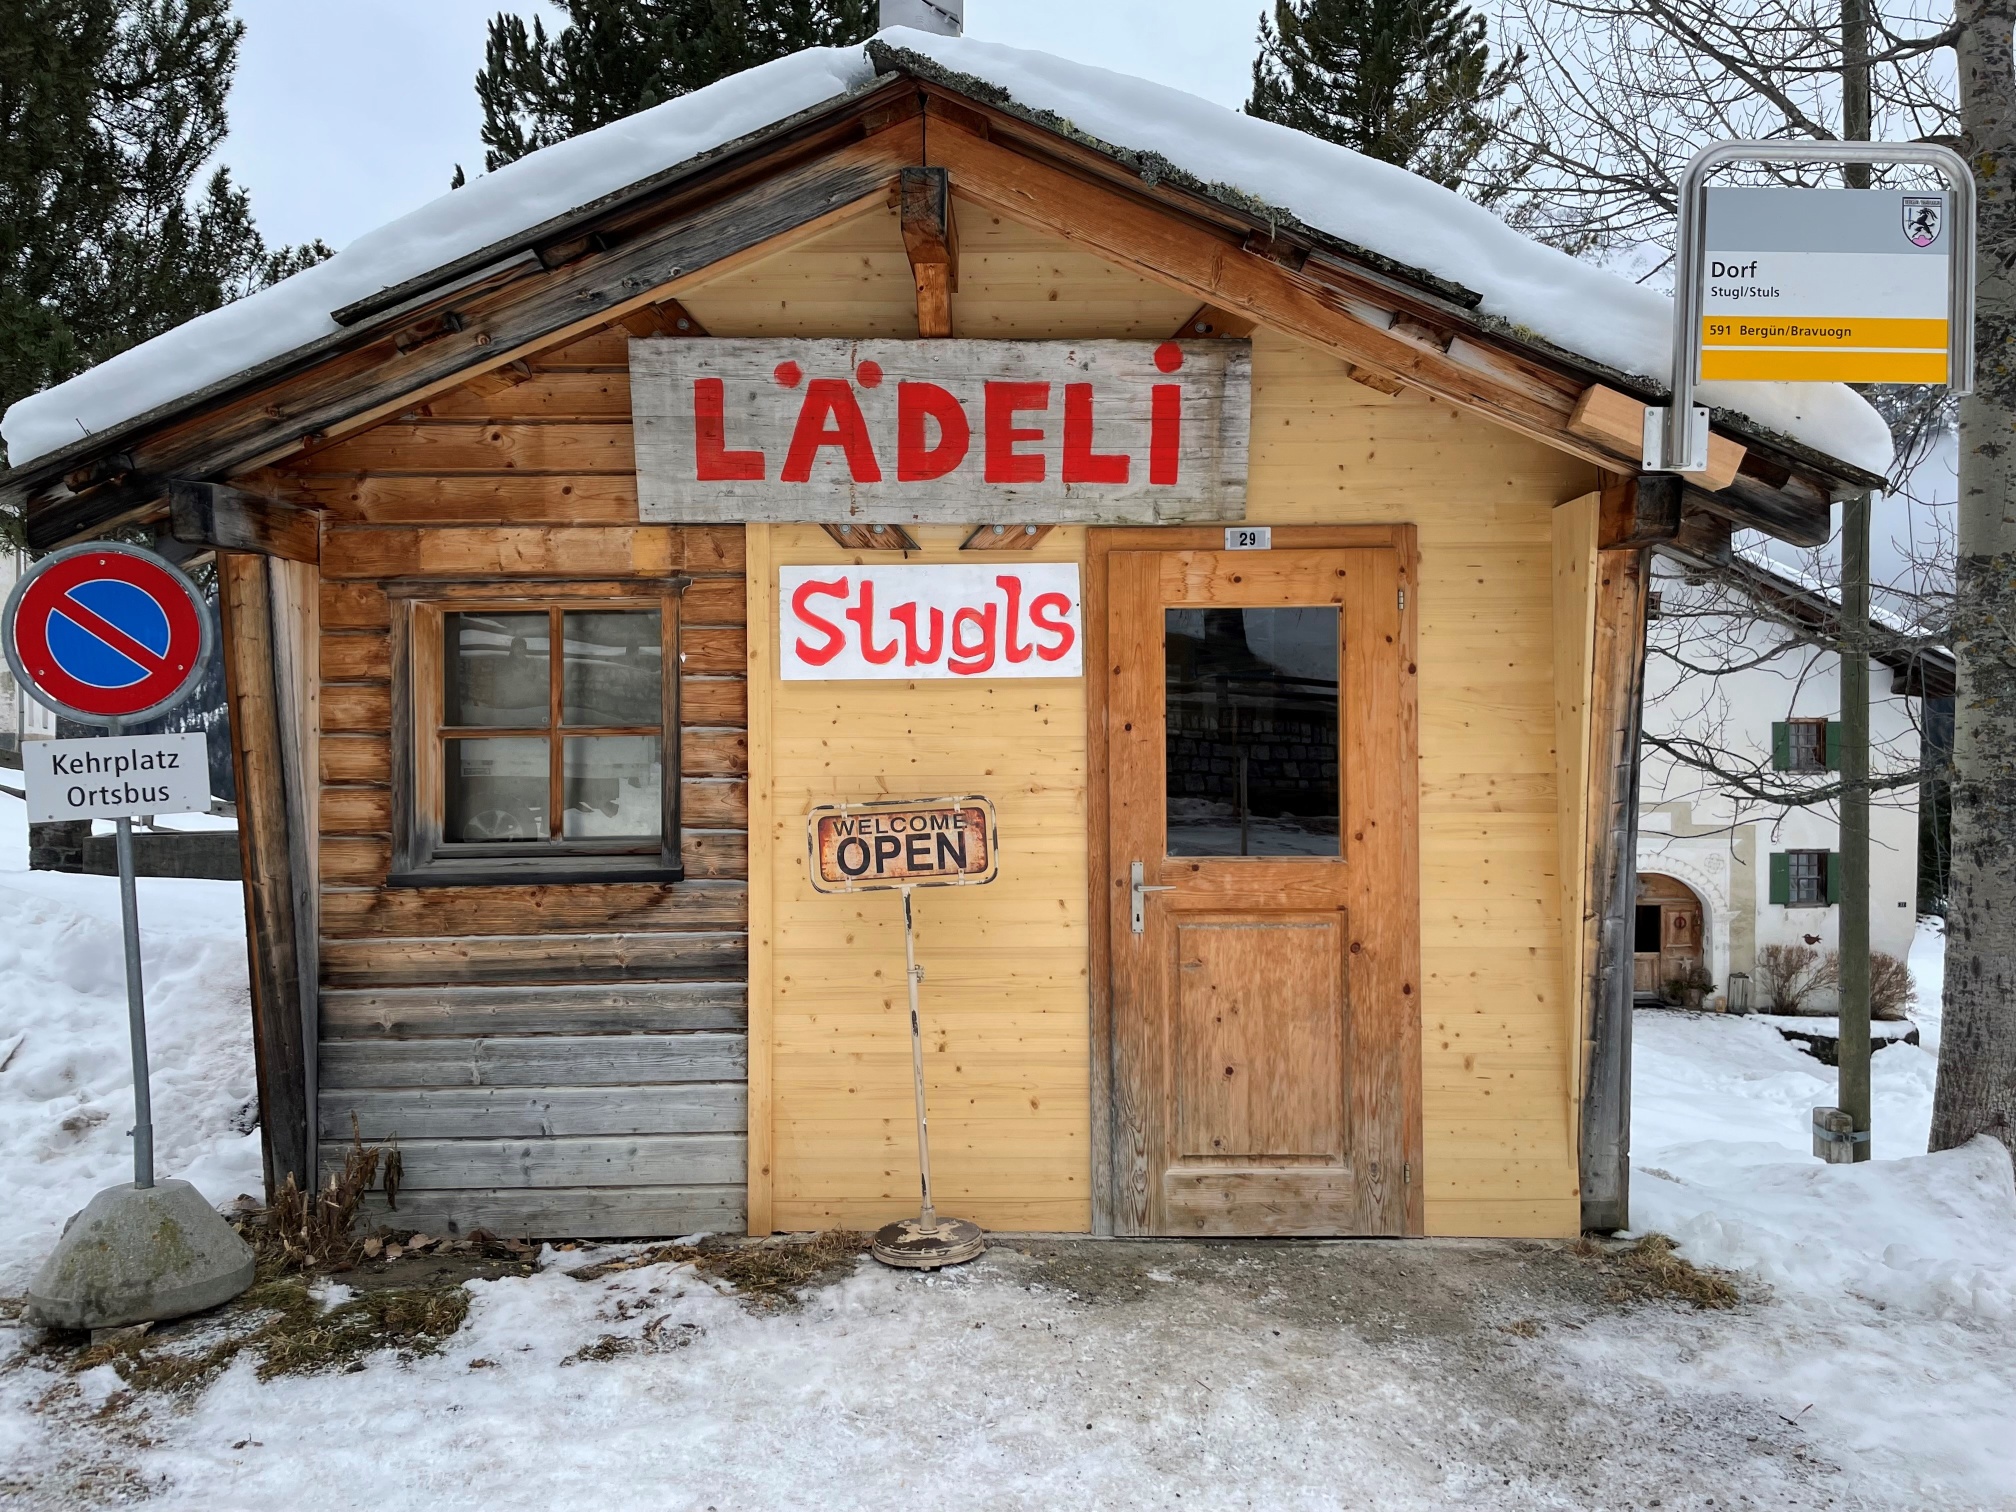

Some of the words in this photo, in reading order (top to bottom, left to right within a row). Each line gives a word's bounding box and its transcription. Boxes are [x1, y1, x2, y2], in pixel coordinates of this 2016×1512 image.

[1711, 261, 1757, 278] Dorf
[1711, 286, 1780, 299] Stugl/Stuls
[1710, 325, 1731, 335] 591
[1740, 325, 1852, 339] Bergün/Bravuogn
[1239, 532, 1256, 546] 29
[792, 575, 1075, 675] Stugls
[52, 749, 180, 777] Kehrplatz
[67, 782, 170, 807] Ortsbus
[833, 814, 967, 836] WELCOME
[837, 831, 967, 875] OPEN
